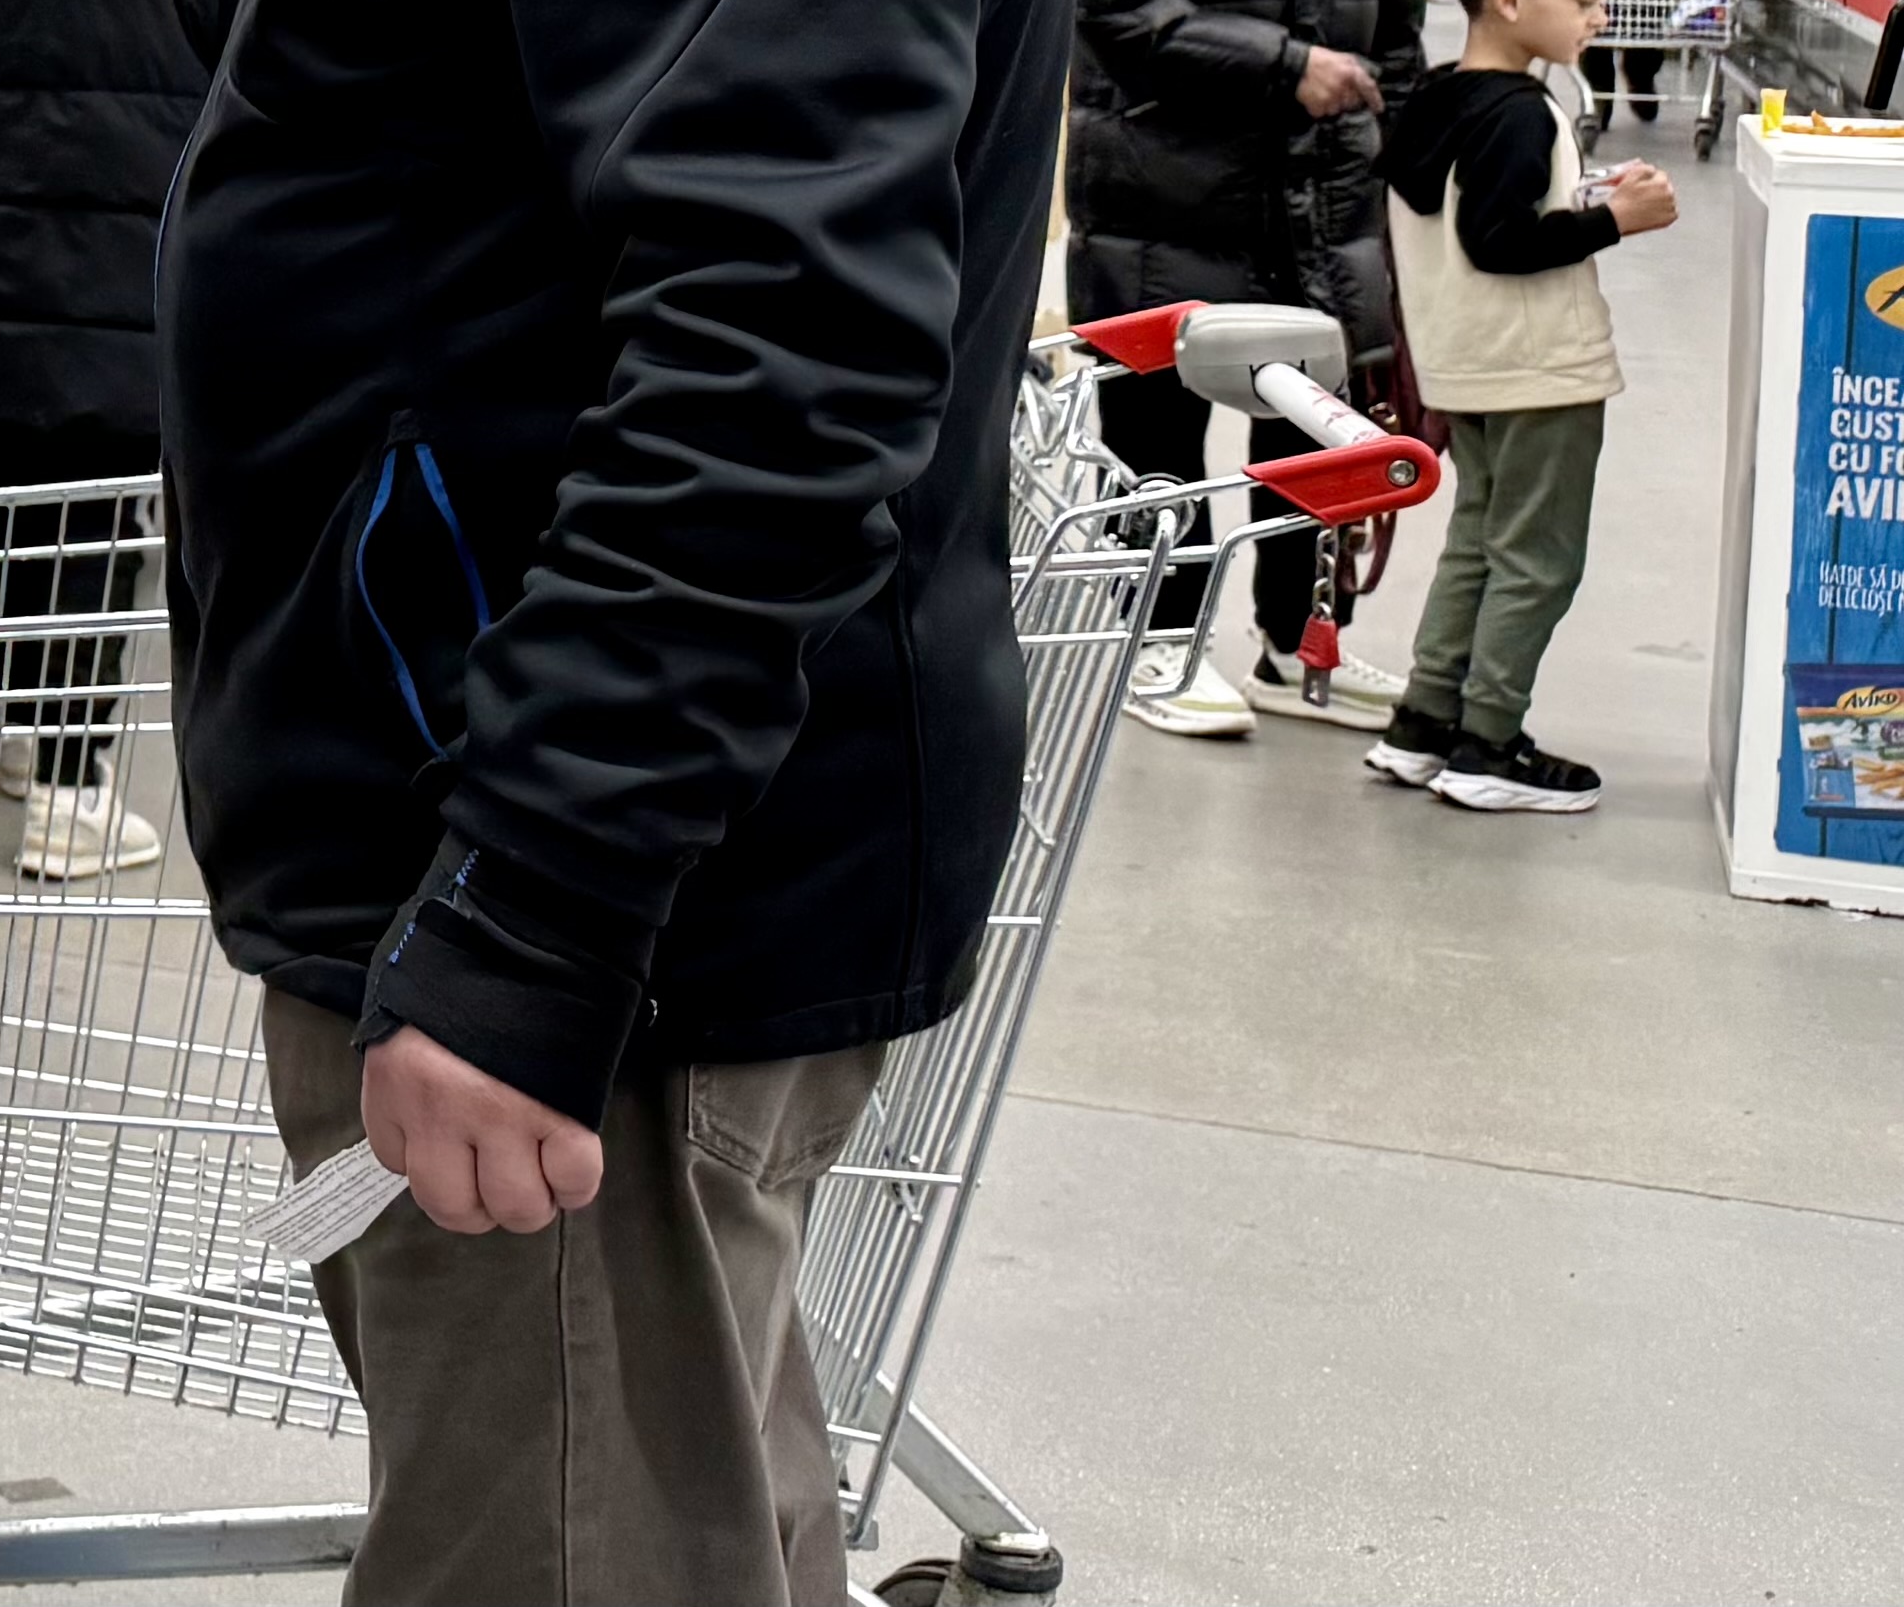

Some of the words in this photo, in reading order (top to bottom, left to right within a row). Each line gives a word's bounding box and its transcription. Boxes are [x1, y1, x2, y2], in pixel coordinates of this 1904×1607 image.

[1831, 366, 1904, 407] ÎNCE
[1828, 442, 1872, 474] CU
[1820, 560, 1866, 589] HAIDE
[1891, 569, 1904, 591] D
